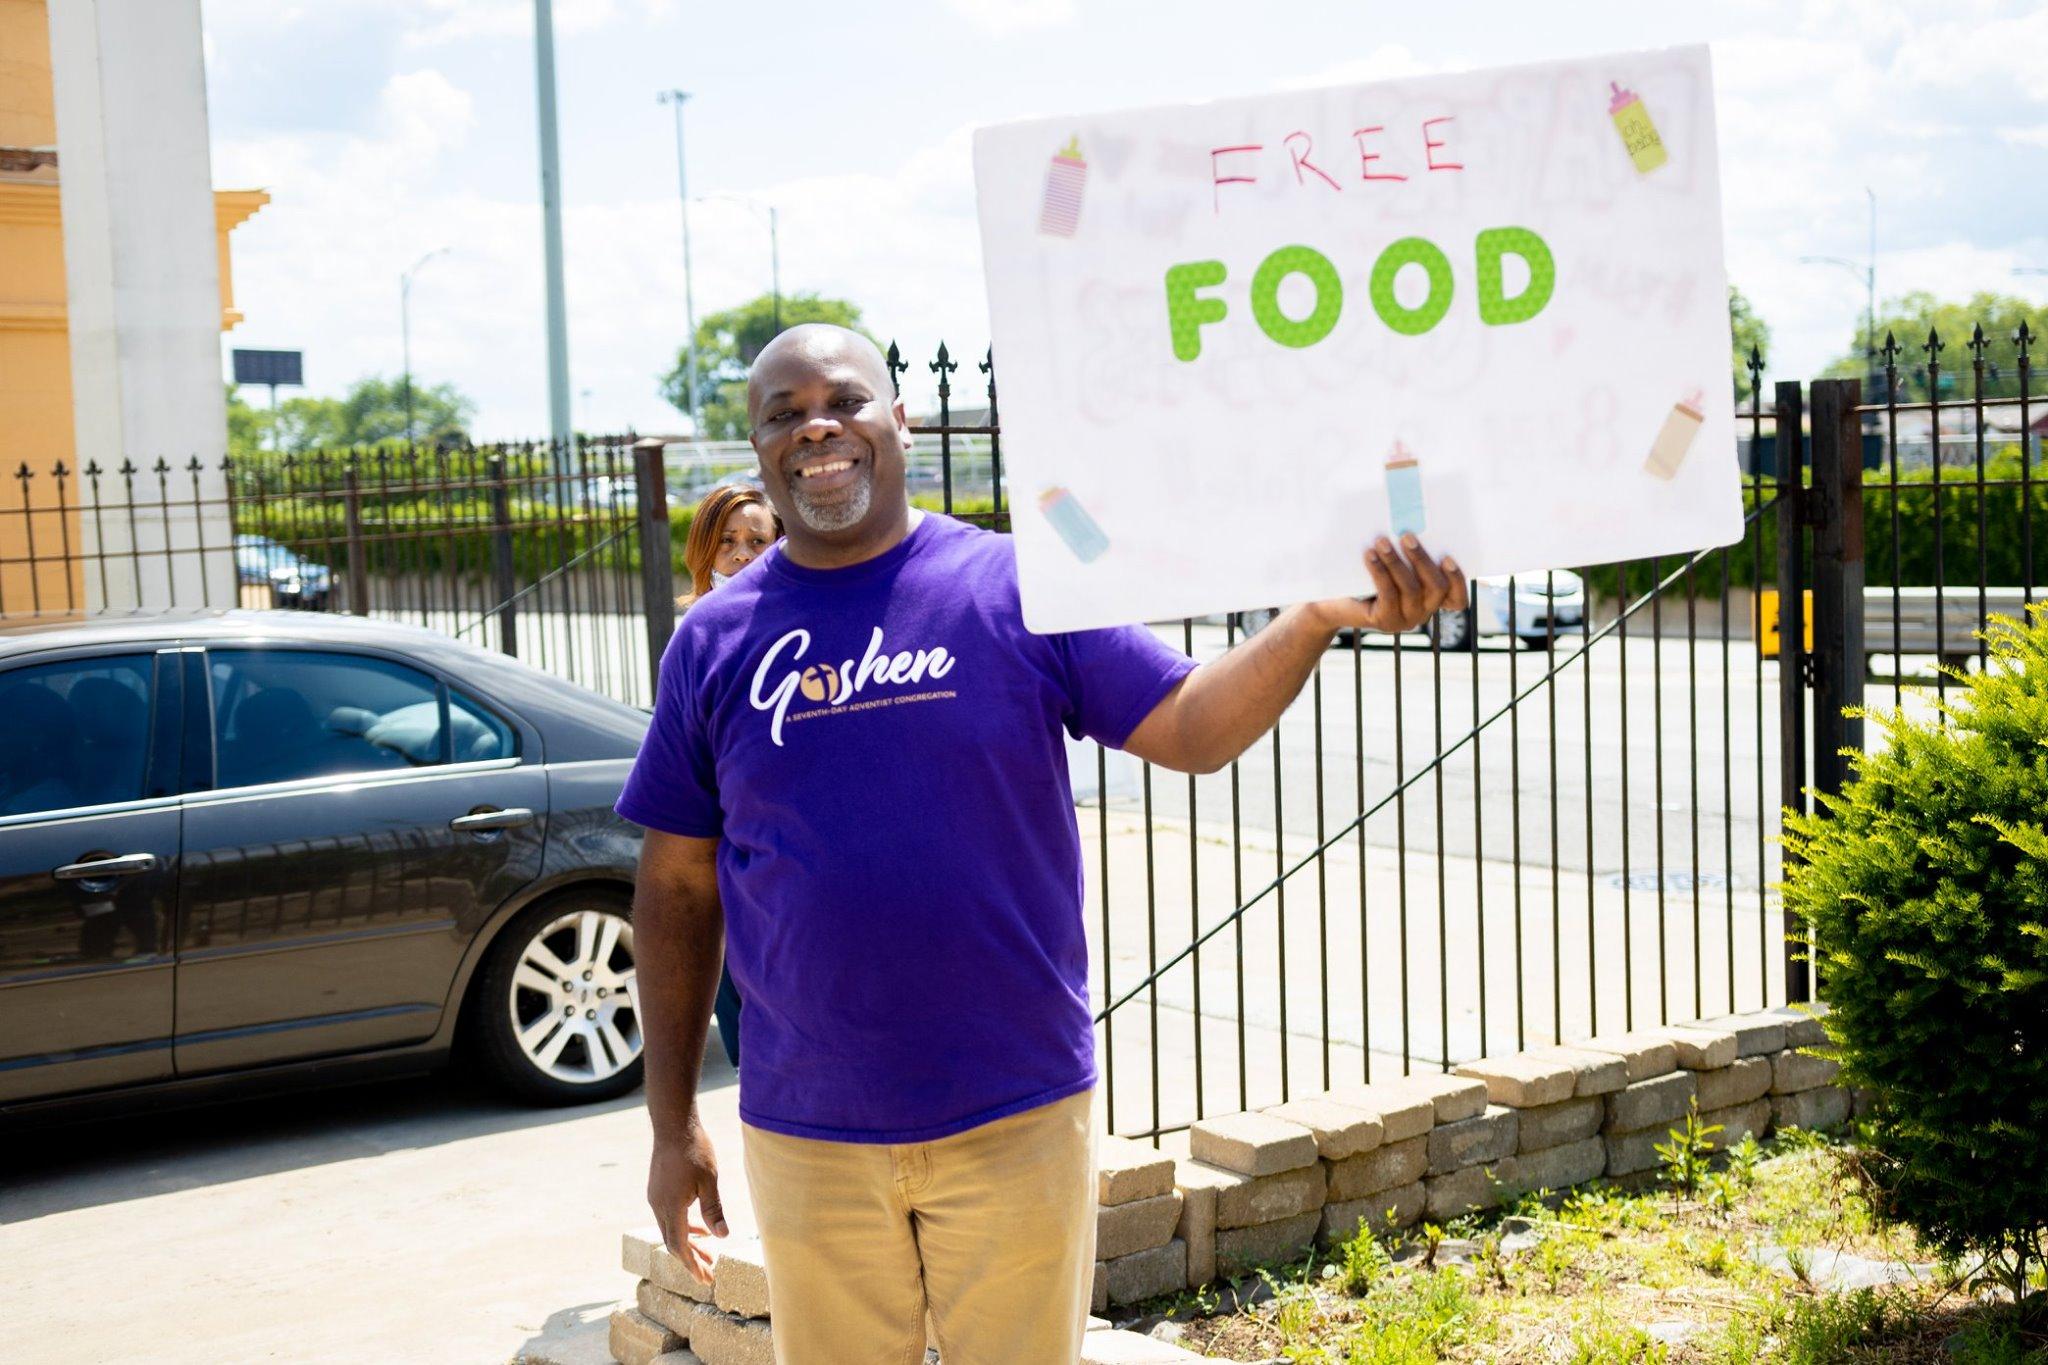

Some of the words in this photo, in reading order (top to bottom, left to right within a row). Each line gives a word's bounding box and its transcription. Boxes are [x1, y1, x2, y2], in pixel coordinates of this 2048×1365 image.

[1211, 116, 1464, 213] FREE
[1165, 226, 1556, 362] FOOD
[749, 626, 956, 746] Goshen
[792, 705, 848, 722] SEVENTH-DAY
[849, 698, 893, 712] ADVENTIST
[894, 691, 957, 705] CONGREGATION
